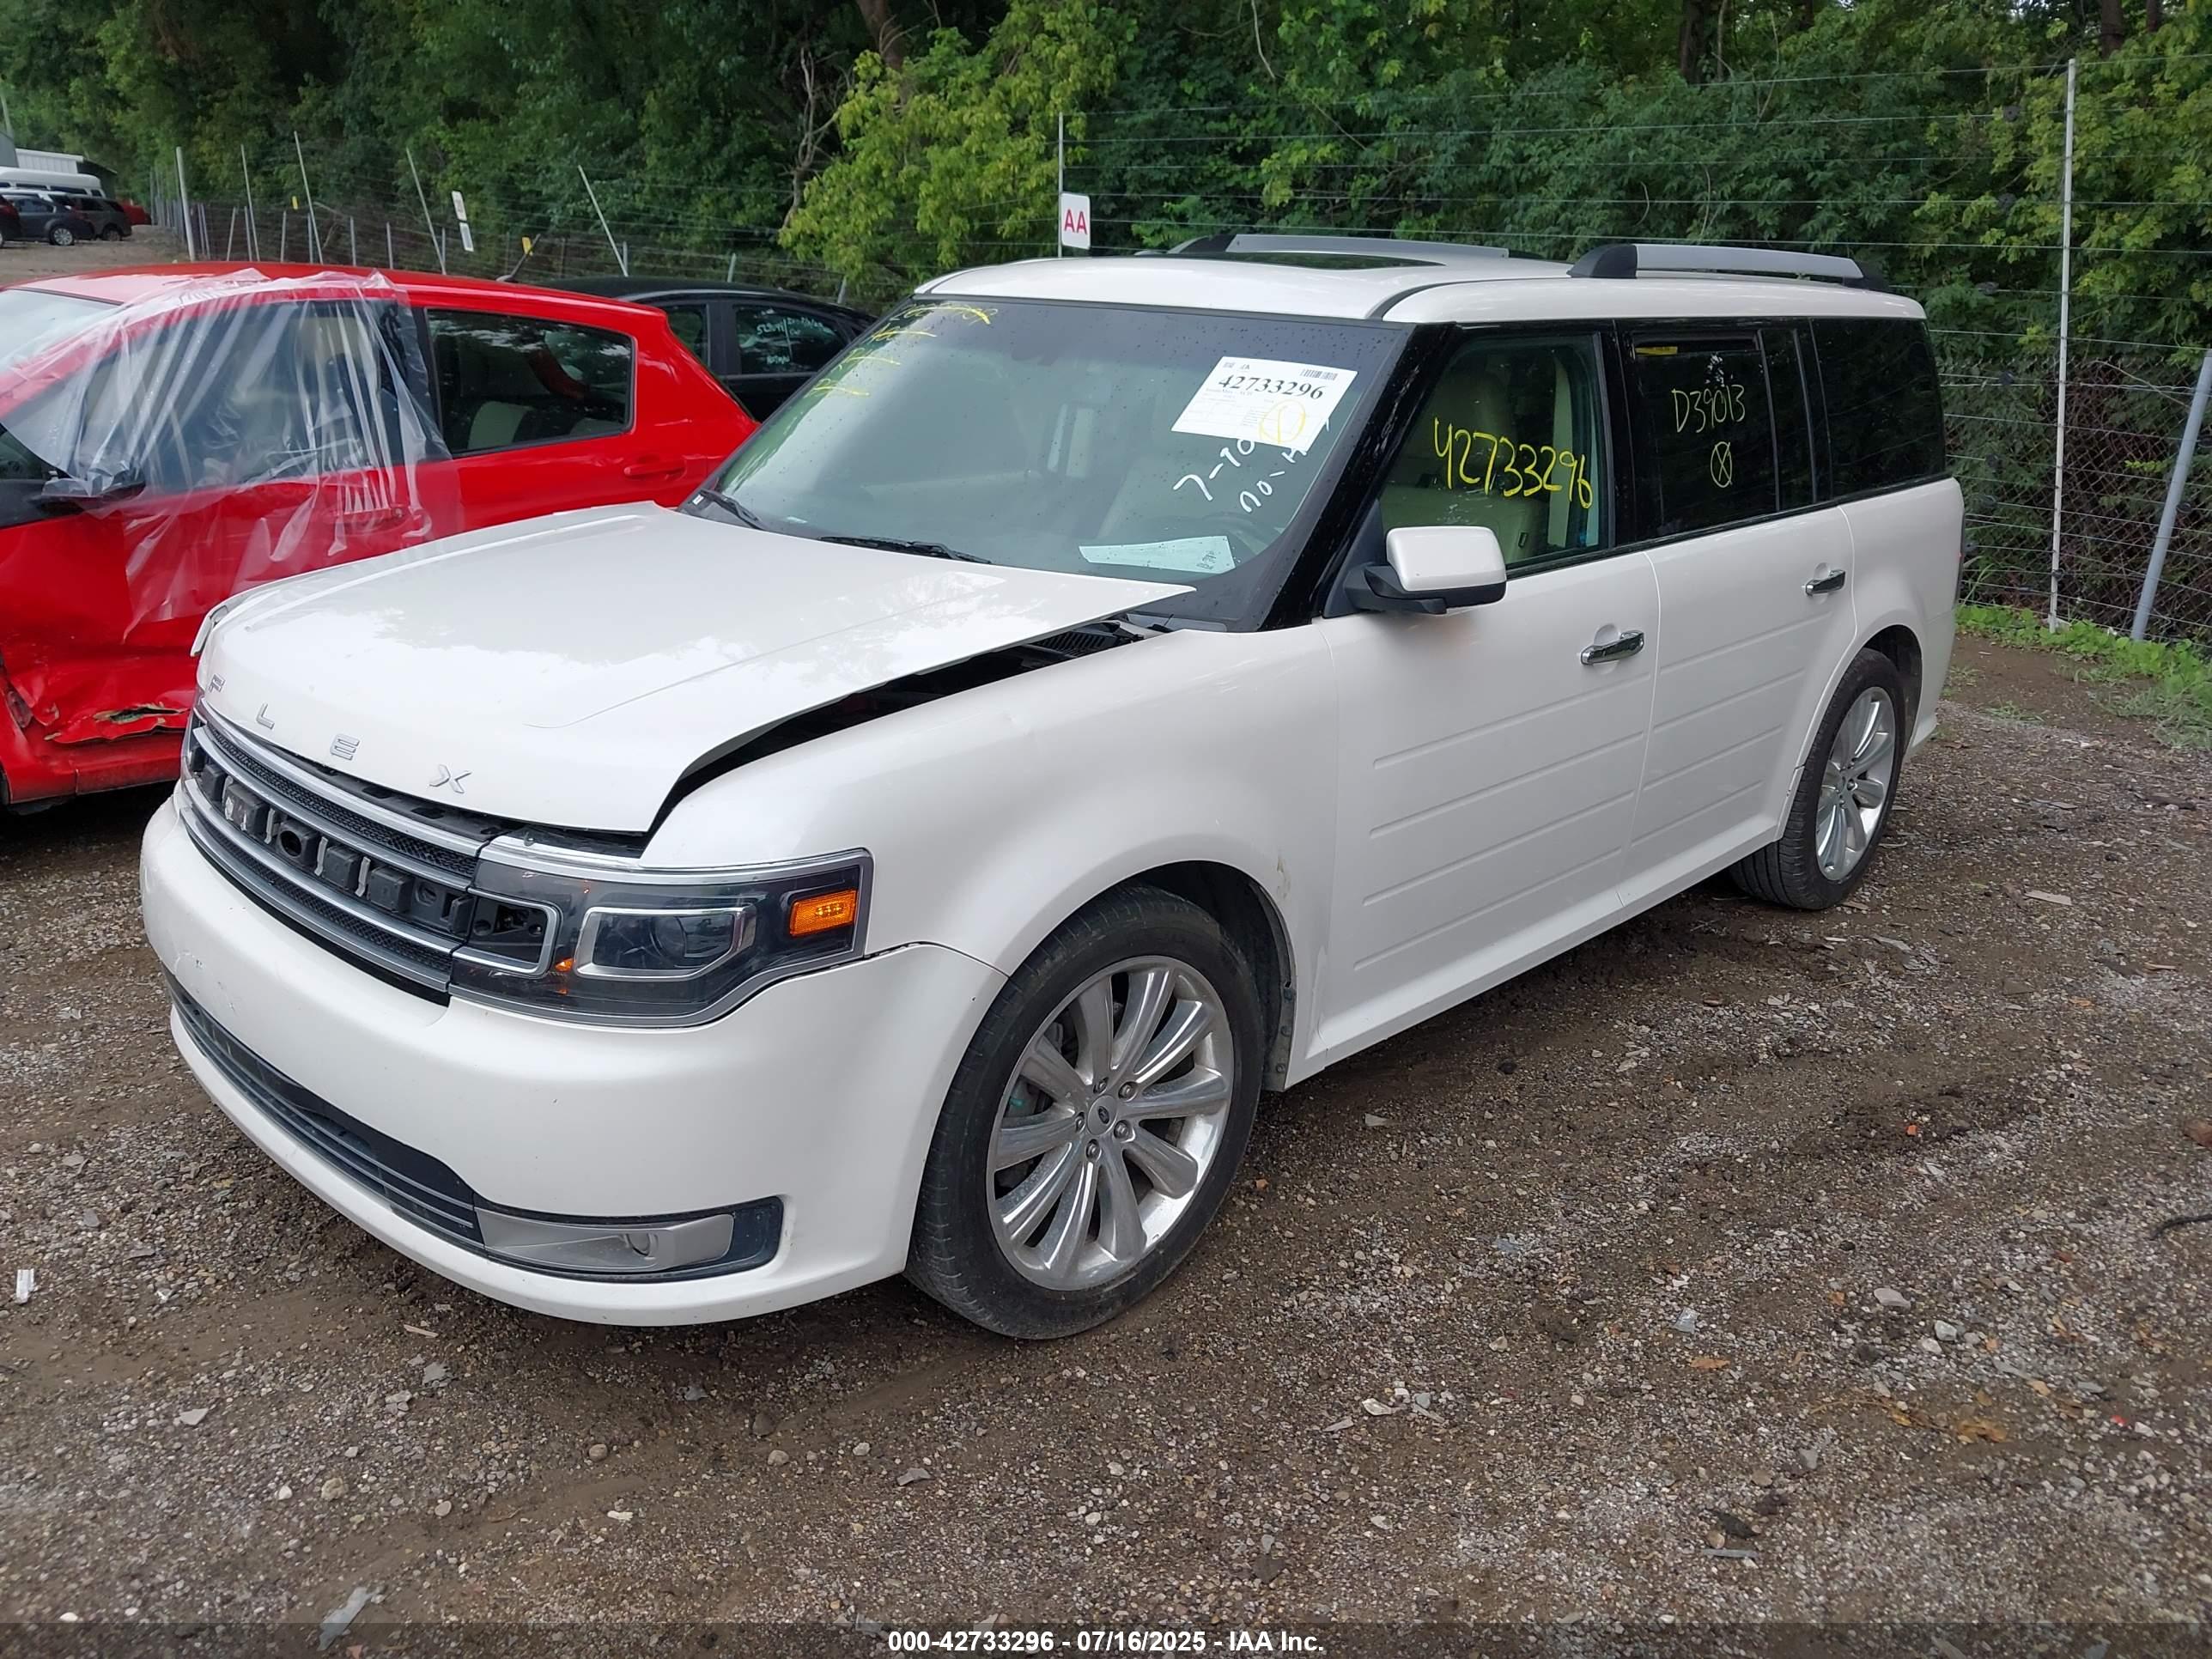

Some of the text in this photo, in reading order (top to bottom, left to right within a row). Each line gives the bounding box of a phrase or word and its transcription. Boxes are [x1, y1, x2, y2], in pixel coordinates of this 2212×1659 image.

[1064, 209, 1088, 235] AA
[1218, 374, 1327, 400] 42733296
[1671, 384, 1746, 434] D39013
[1434, 416, 1594, 509] 42733296
[208, 674, 471, 794] FLEX
